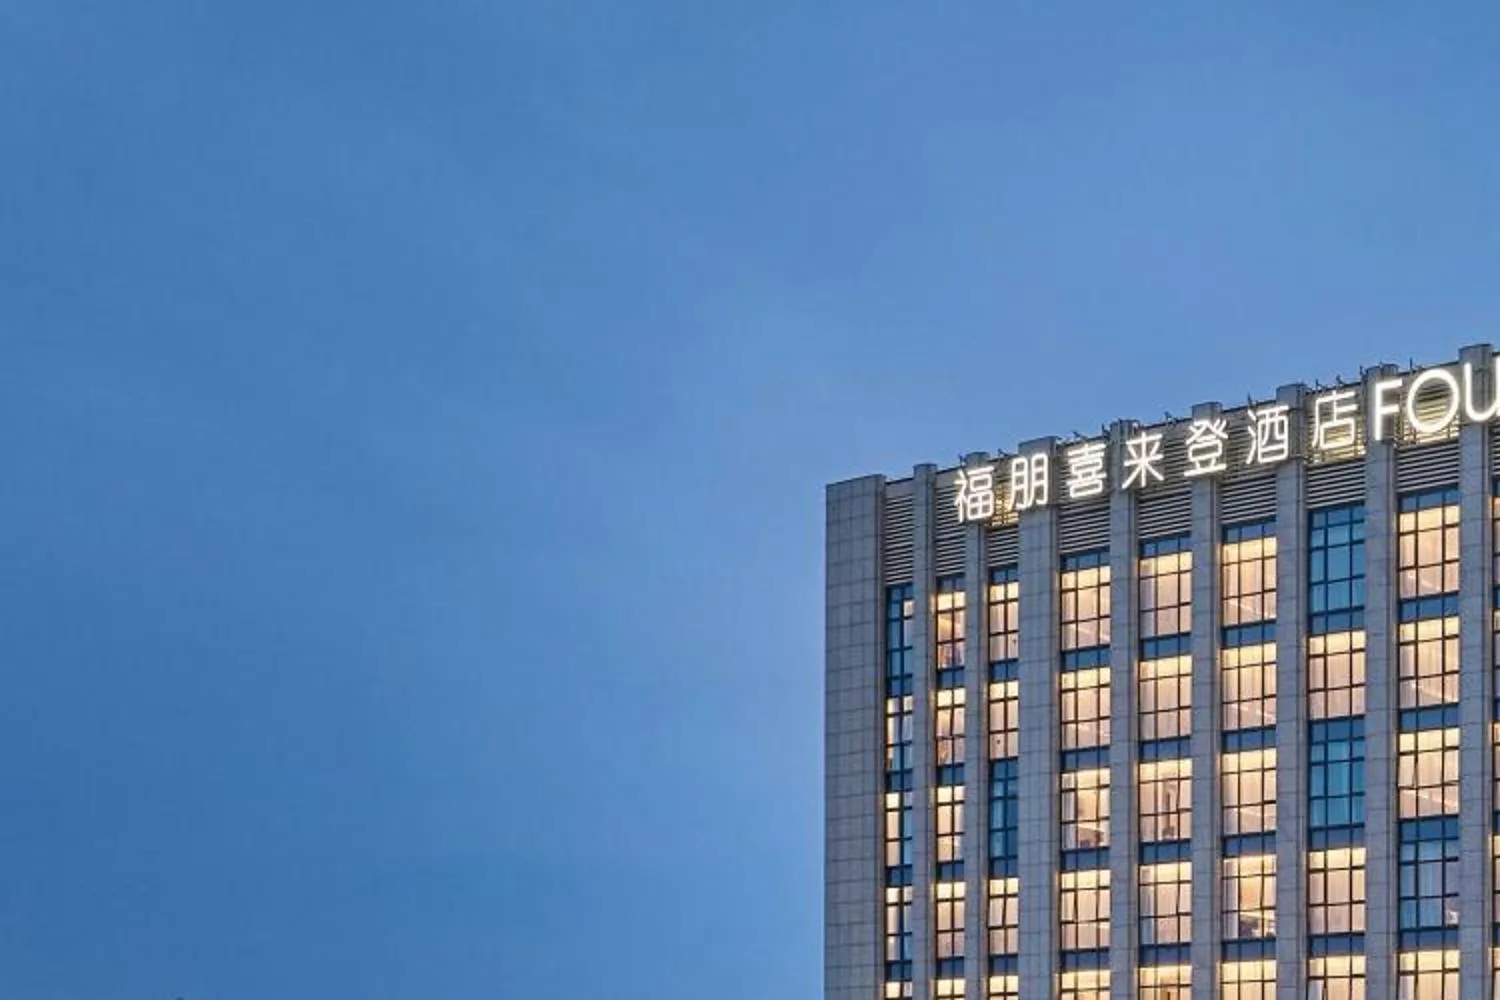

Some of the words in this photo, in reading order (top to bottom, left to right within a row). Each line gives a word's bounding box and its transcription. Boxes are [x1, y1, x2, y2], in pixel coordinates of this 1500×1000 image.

[953, 389, 1359, 524] 福朋喜来登酒店
